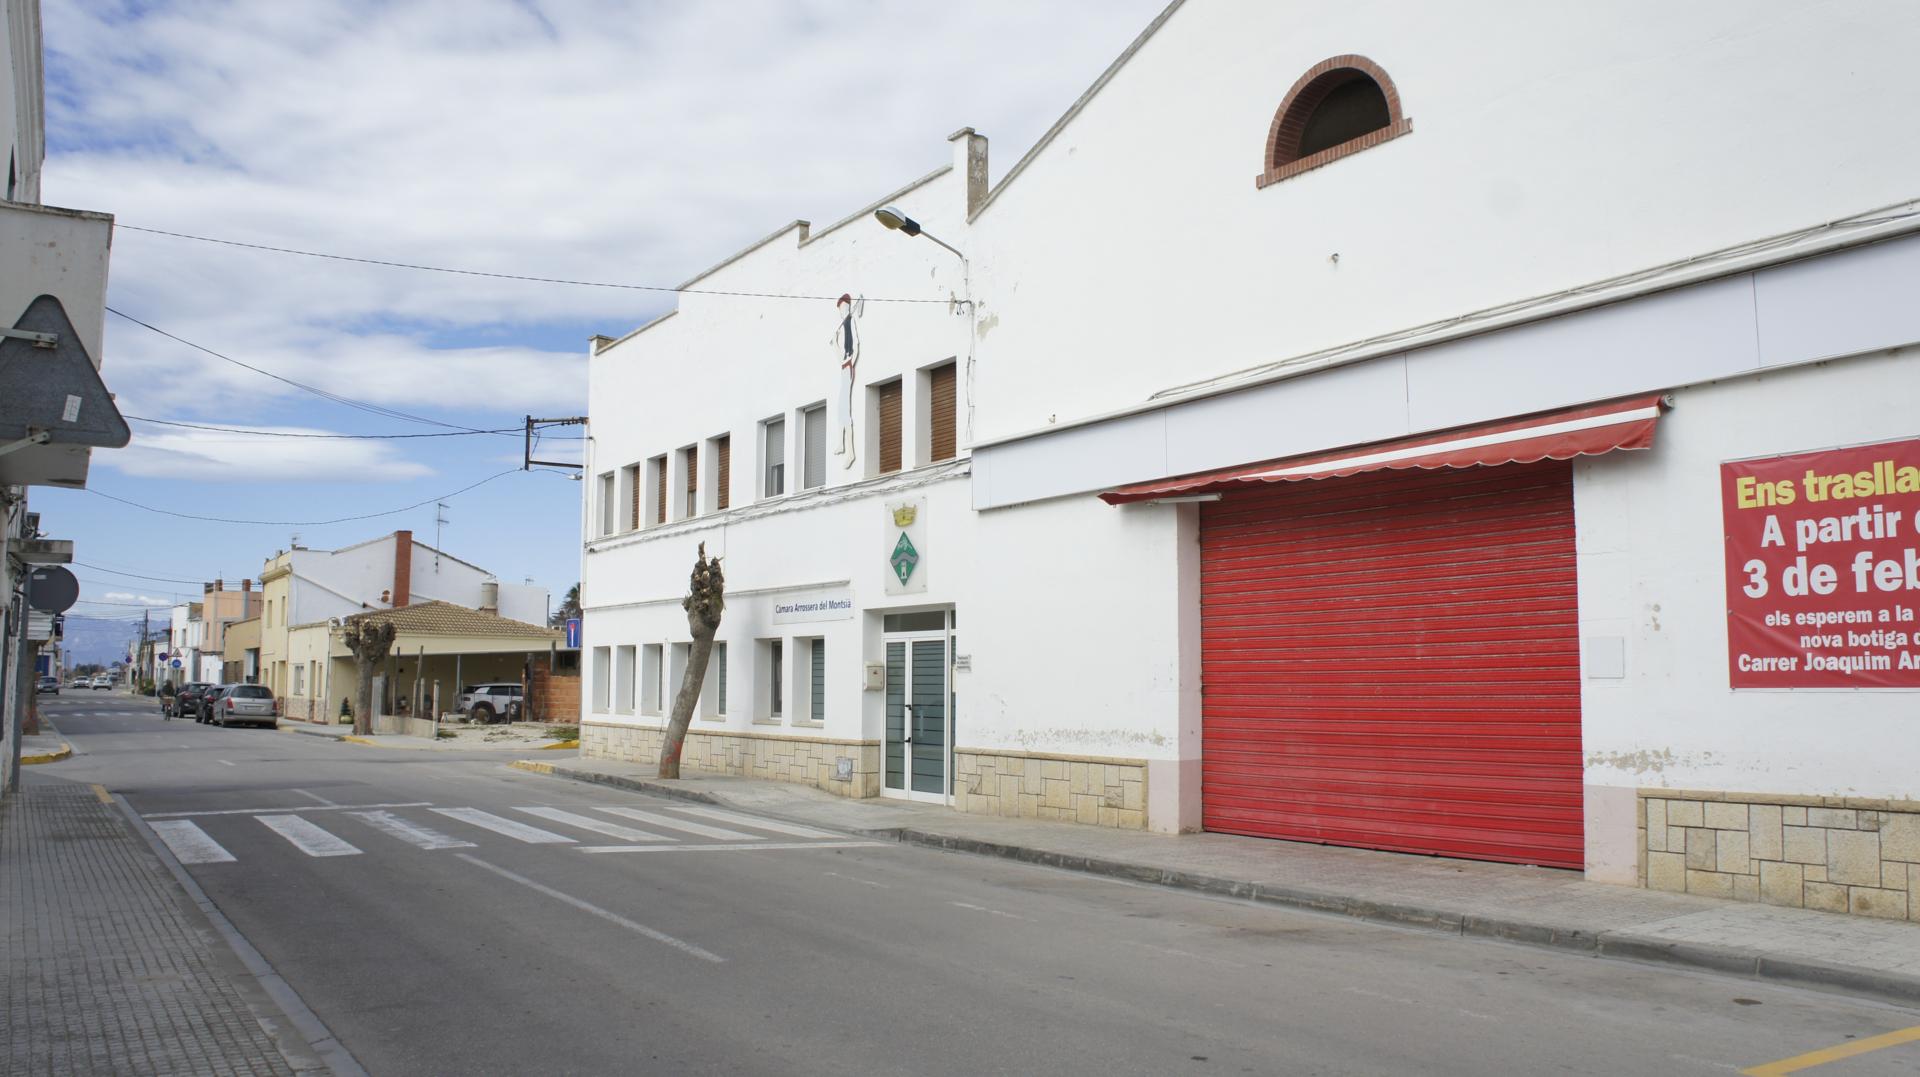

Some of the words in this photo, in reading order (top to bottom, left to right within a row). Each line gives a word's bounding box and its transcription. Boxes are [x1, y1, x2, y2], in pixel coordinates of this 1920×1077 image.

[1736, 475, 1796, 509] Ens
[1803, 460, 1920, 502] traslla
[1760, 514, 1786, 547] A
[1796, 504, 1901, 552] partir
[1742, 558, 1769, 599] 3
[1782, 556, 1838, 596] de
[794, 603, 819, 612] Arrossera
[819, 600, 828, 610] del
[1765, 610, 1791, 626] els
[1795, 609, 1872, 629] esperem
[1878, 609, 1890, 622] a
[1895, 604, 1914, 622] la
[1800, 632, 1843, 649] nova
[1847, 629, 1908, 650] botiga
[1738, 653, 1798, 672] Carrer
[1803, 651, 1890, 675] Joaquim
